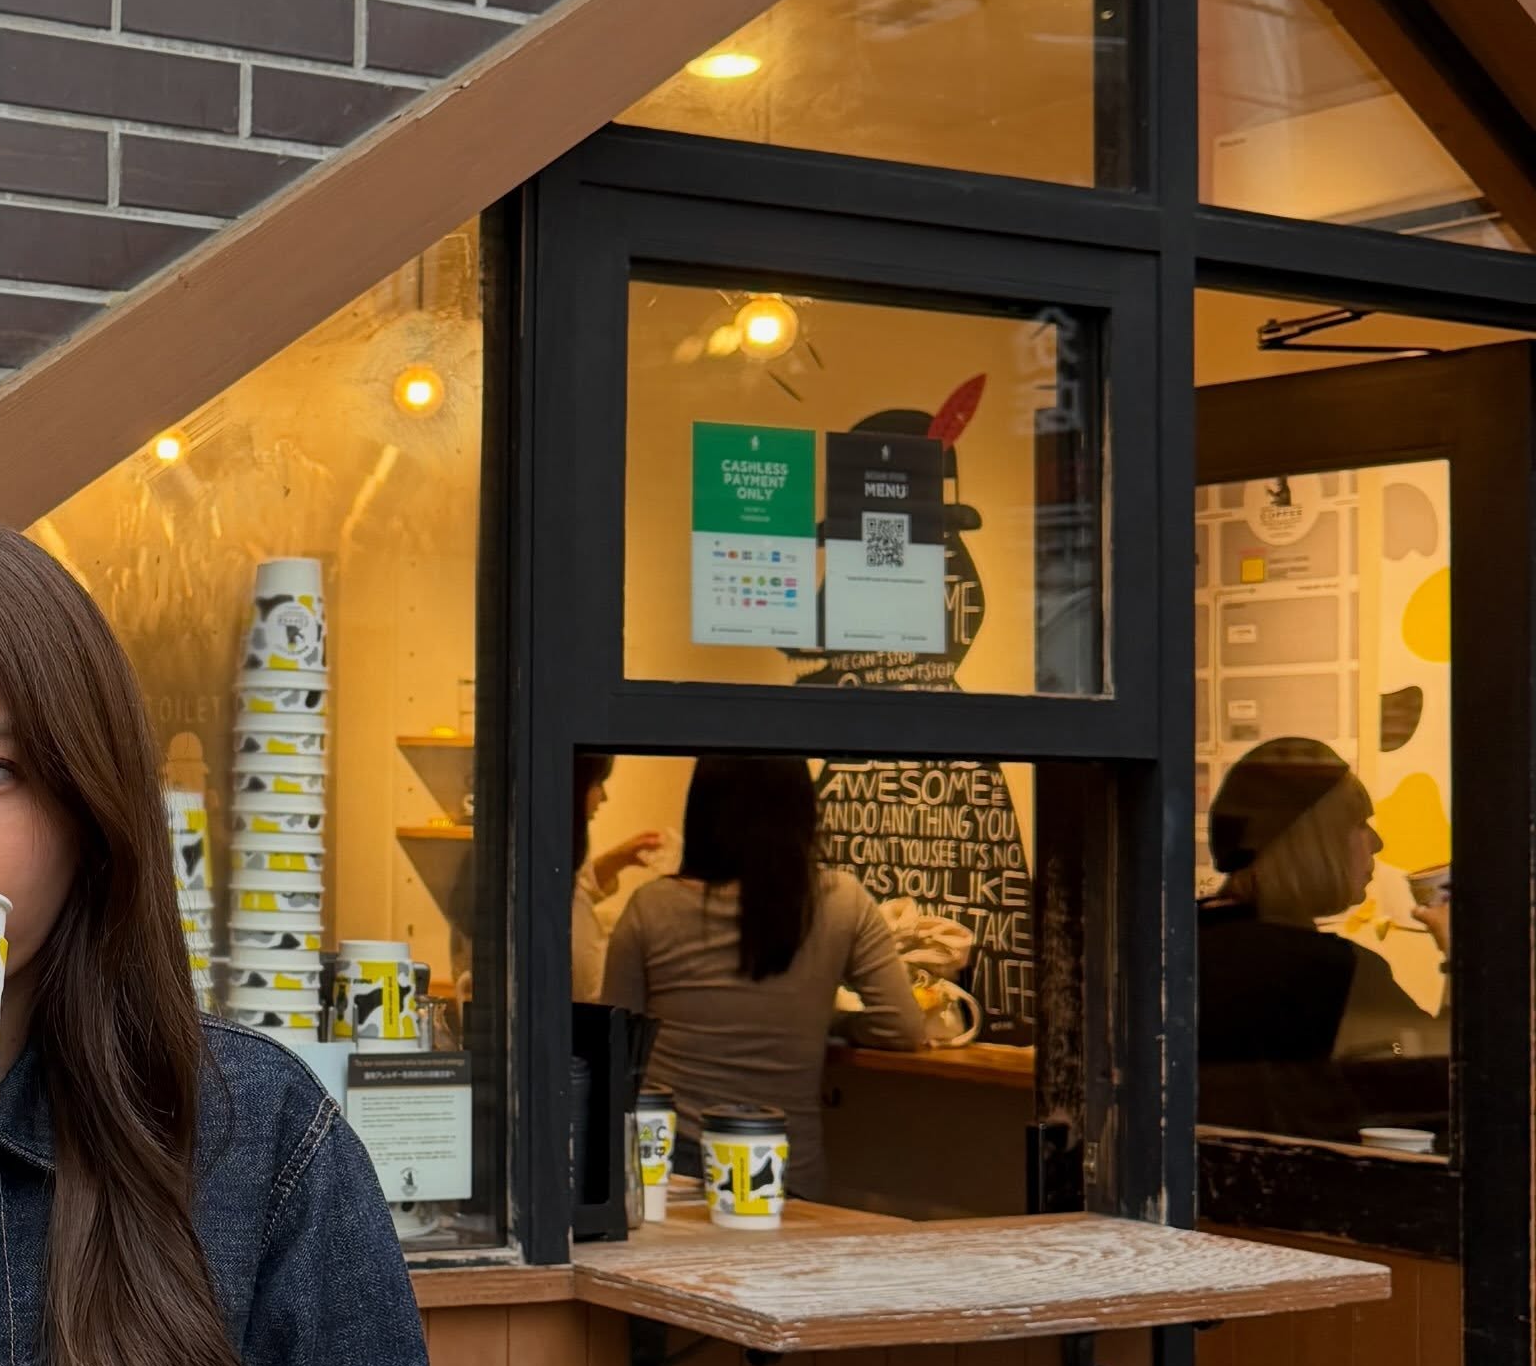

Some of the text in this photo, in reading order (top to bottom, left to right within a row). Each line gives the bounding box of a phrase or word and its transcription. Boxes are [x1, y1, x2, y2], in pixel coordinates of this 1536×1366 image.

[721, 459, 790, 476] CASHLESS
[723, 472, 787, 489] PAYMENT
[736, 486, 775, 501] ONLY
[864, 482, 909, 499] MENU
[819, 769, 991, 806] AWESOME
[851, 801, 880, 835] DO
[880, 803, 974, 840] ANYTHING
[974, 807, 1015, 842] YOU
[993, 841, 1022, 869] NO
[894, 866, 940, 899] YOU
[944, 870, 1030, 907] LIKE
[967, 907, 1034, 955] TAKE
